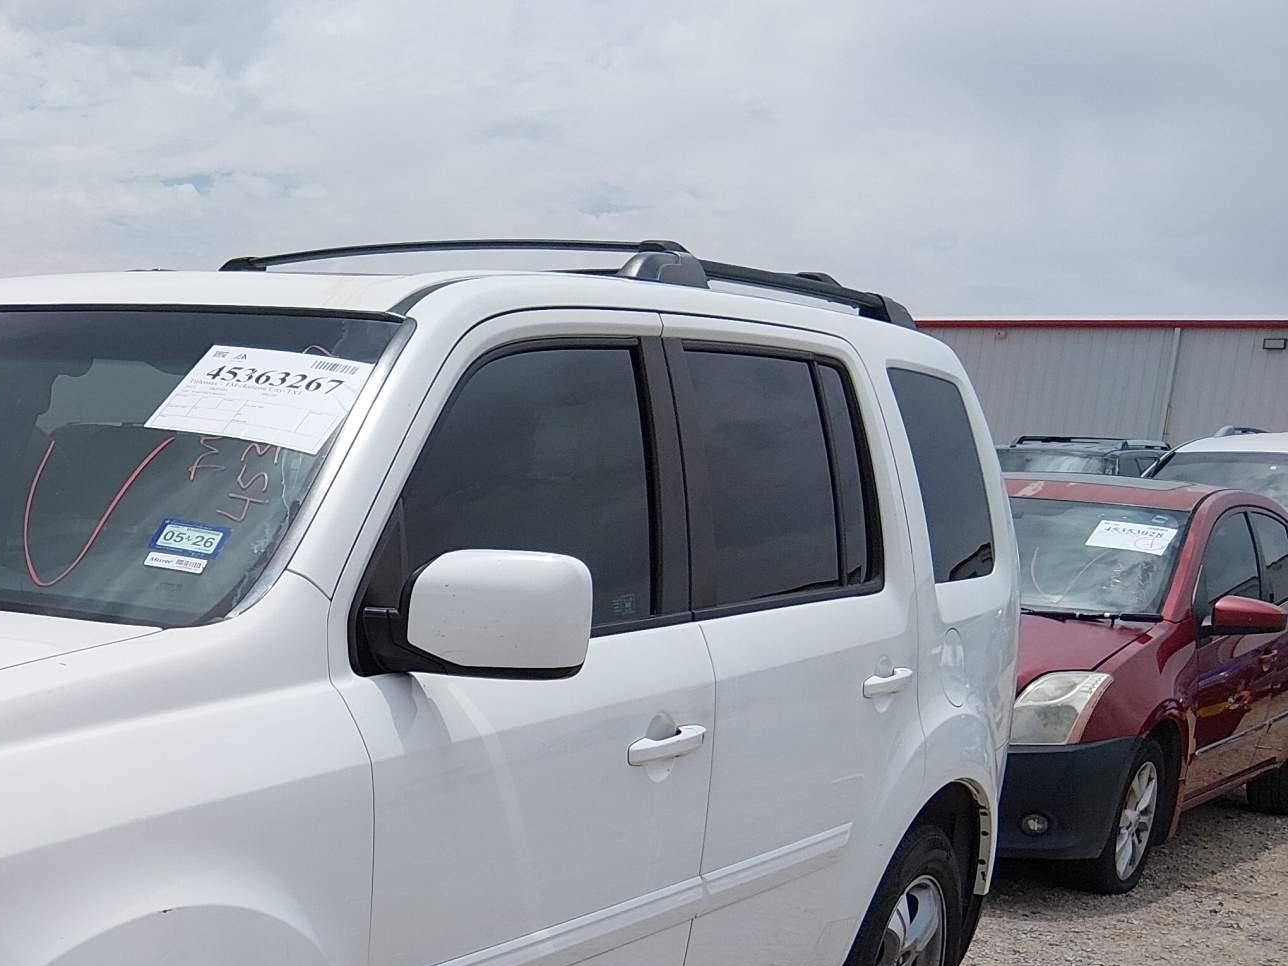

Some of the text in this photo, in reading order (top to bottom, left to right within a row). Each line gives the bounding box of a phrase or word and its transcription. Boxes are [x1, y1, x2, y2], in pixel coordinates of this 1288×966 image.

[206, 365, 345, 395] 45363267
[163, 530, 216, 548] 05 26
